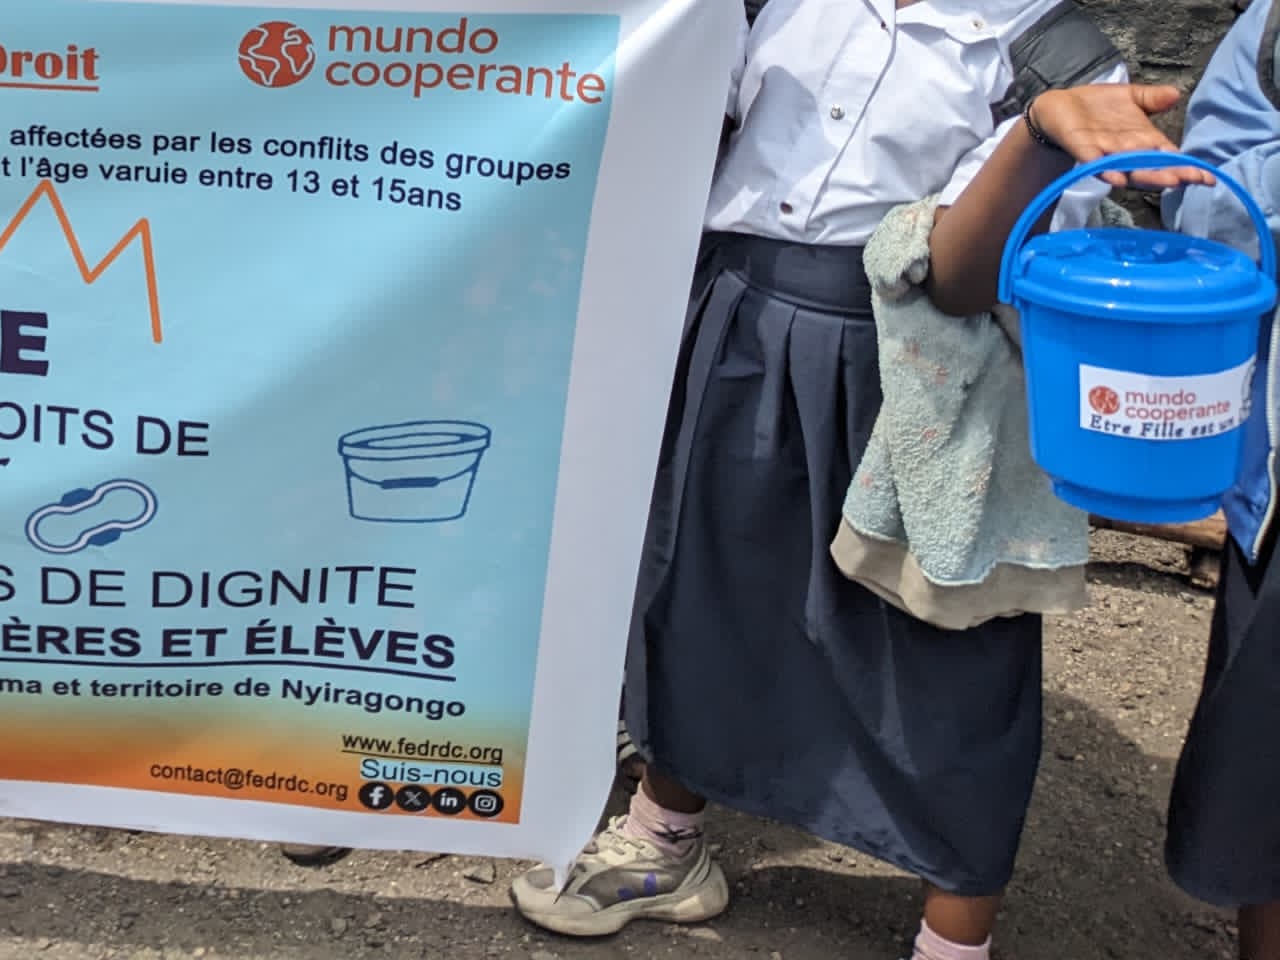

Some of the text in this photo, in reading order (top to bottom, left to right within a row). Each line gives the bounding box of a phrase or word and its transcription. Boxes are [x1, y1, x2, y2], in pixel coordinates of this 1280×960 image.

[327, 17, 498, 54] mundo
[324, 58, 607, 105] cooperante
[10, 124, 142, 151] affectées
[153, 132, 200, 157] par
[211, 132, 252, 155] les
[263, 137, 369, 163] conflits
[380, 141, 434, 169] des
[446, 150, 571, 186] groupes
[21, 155, 88, 183] l'âge
[99, 161, 188, 186] varuie
[199, 166, 273, 191] entre
[287, 170, 321, 194] 13
[331, 174, 359, 198] et
[372, 178, 462, 211] 15ans
[1125, 389, 1197, 405] mundo
[1125, 400, 1231, 421] cooperante
[136, 415, 210, 458] DE
[1090, 414, 1131, 434] Etre
[1141, 422, 1184, 438] Fille
[1191, 422, 1215, 436] est
[40, 566, 127, 608] DE
[151, 564, 418, 609] DIGNITE
[160, 627, 228, 658] ET
[244, 616, 456, 670] ÉLÈVES
[52, 675, 81, 697] et
[90, 676, 224, 700] territoire
[233, 675, 271, 699] de
[280, 676, 466, 722] Nyiragongo
[342, 734, 503, 762] www.fedrdc.org
[150, 763, 348, 802] contact@fedrdc.org
[360, 759, 502, 788] Suis-nous
